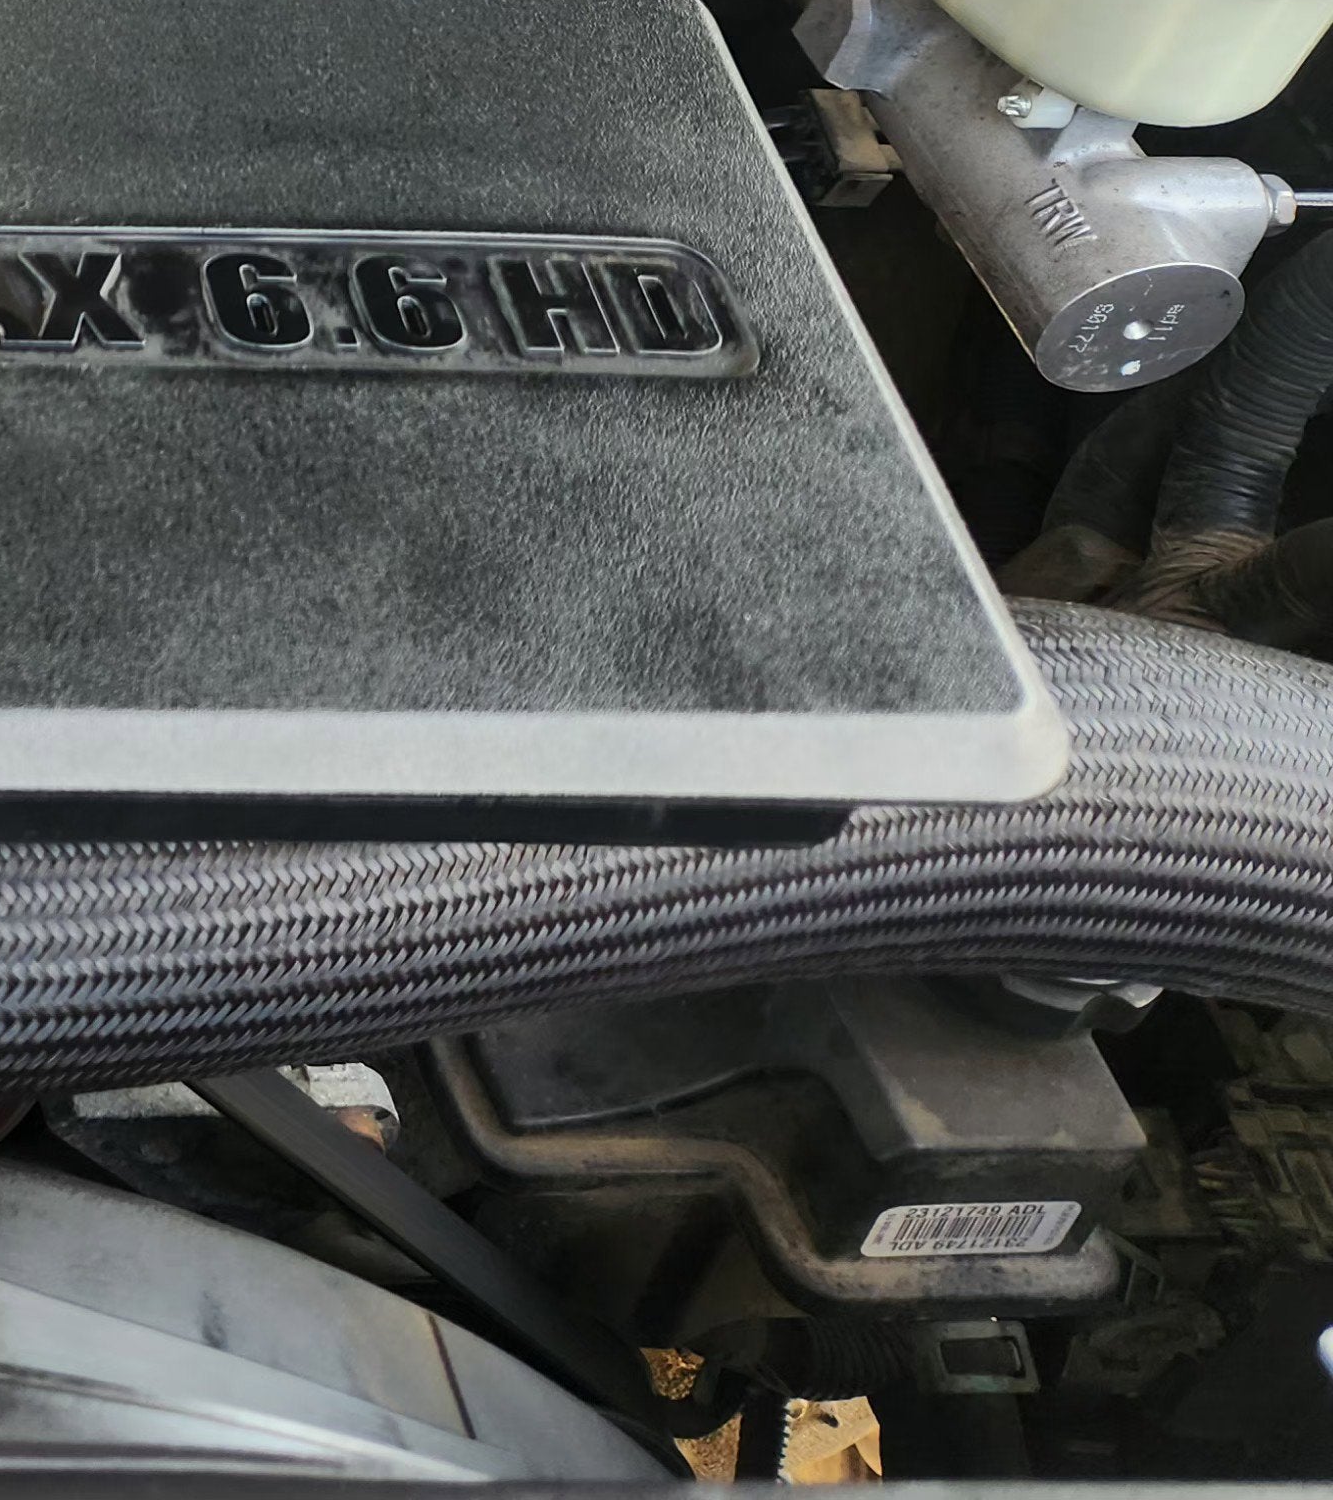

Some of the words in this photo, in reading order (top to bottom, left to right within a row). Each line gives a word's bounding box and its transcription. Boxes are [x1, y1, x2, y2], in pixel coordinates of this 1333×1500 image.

[1024, 183, 1098, 249] TRW
[202, 252, 468, 354] 6.6
[488, 257, 724, 356] HD
[905, 1205, 1002, 1219] 23121749
[1008, 1204, 1047, 1216] ADL
[889, 1240, 927, 1252] ADL
